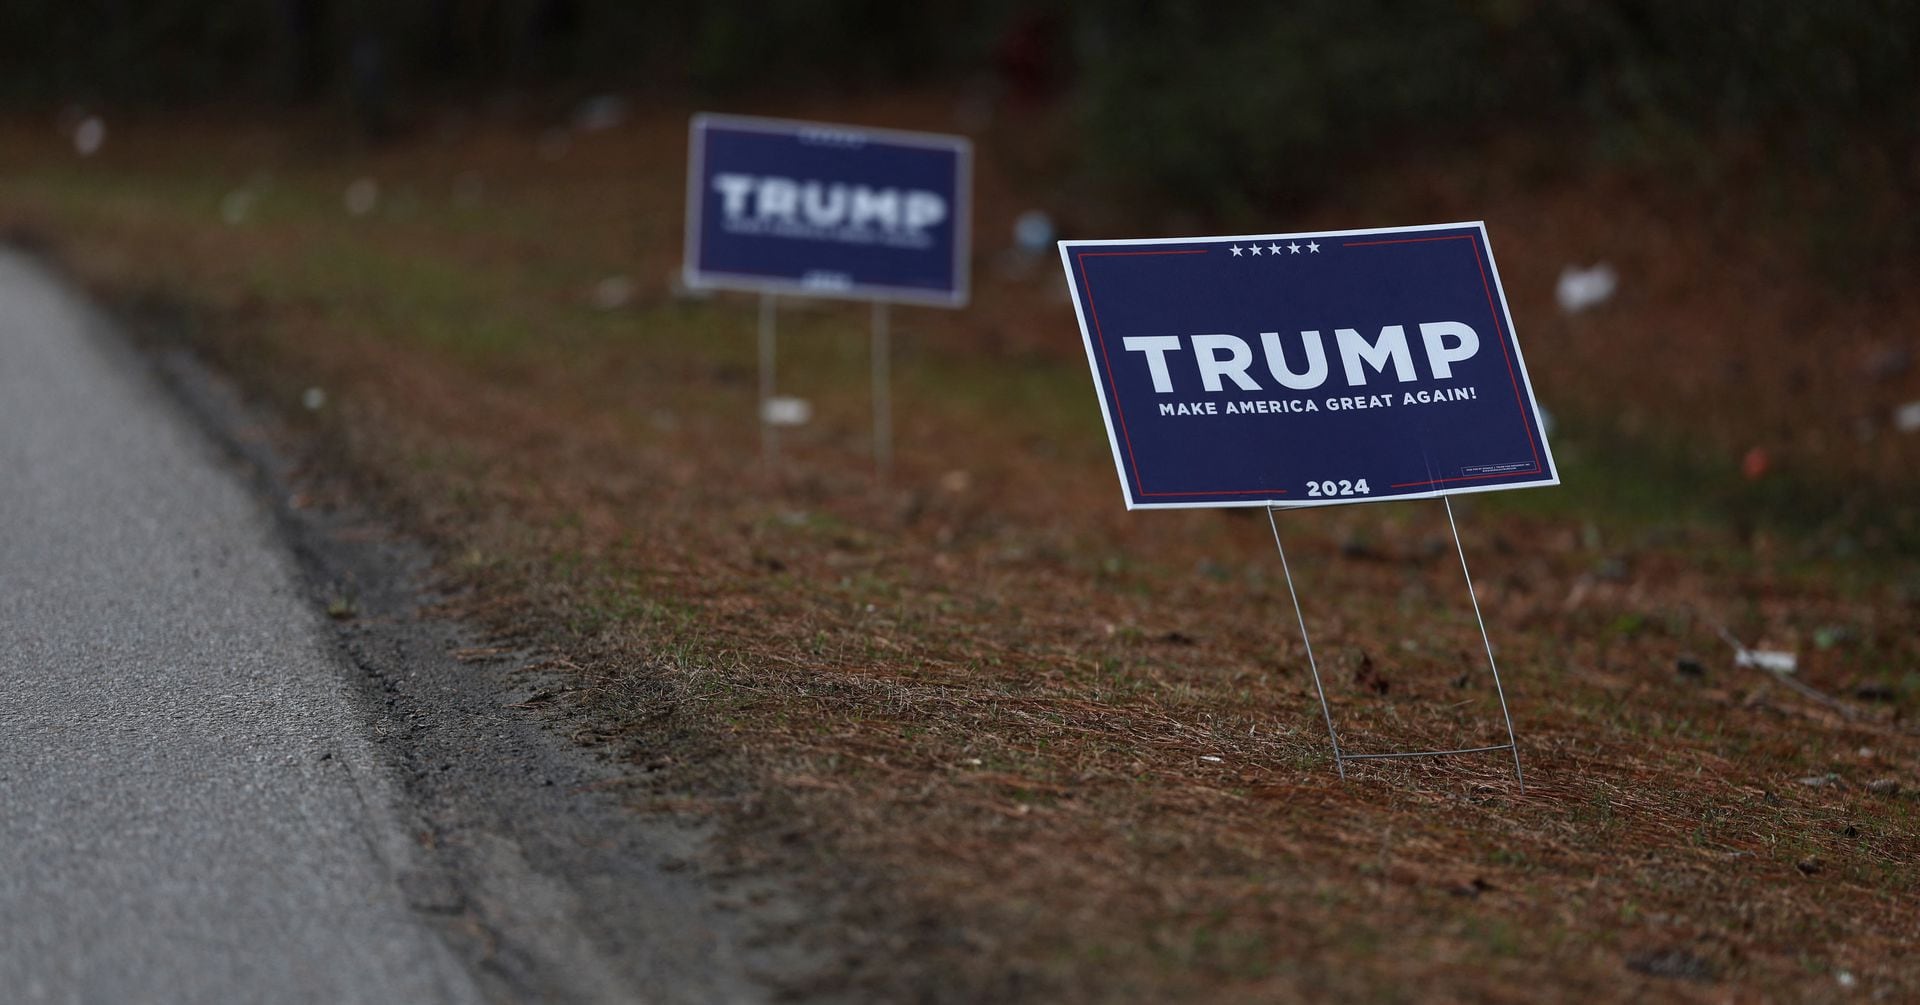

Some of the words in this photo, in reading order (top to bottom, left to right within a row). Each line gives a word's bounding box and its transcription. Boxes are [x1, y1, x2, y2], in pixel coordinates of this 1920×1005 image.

[714, 174, 946, 232] TRUMP
[1122, 321, 1480, 393] TRUMP
[1158, 402, 1218, 416] MAKE
[1225, 399, 1319, 414] AMERICA
[1325, 394, 1393, 411] GREAT
[1403, 386, 1477, 406] AGAIN!
[1305, 478, 1370, 497] 2024
